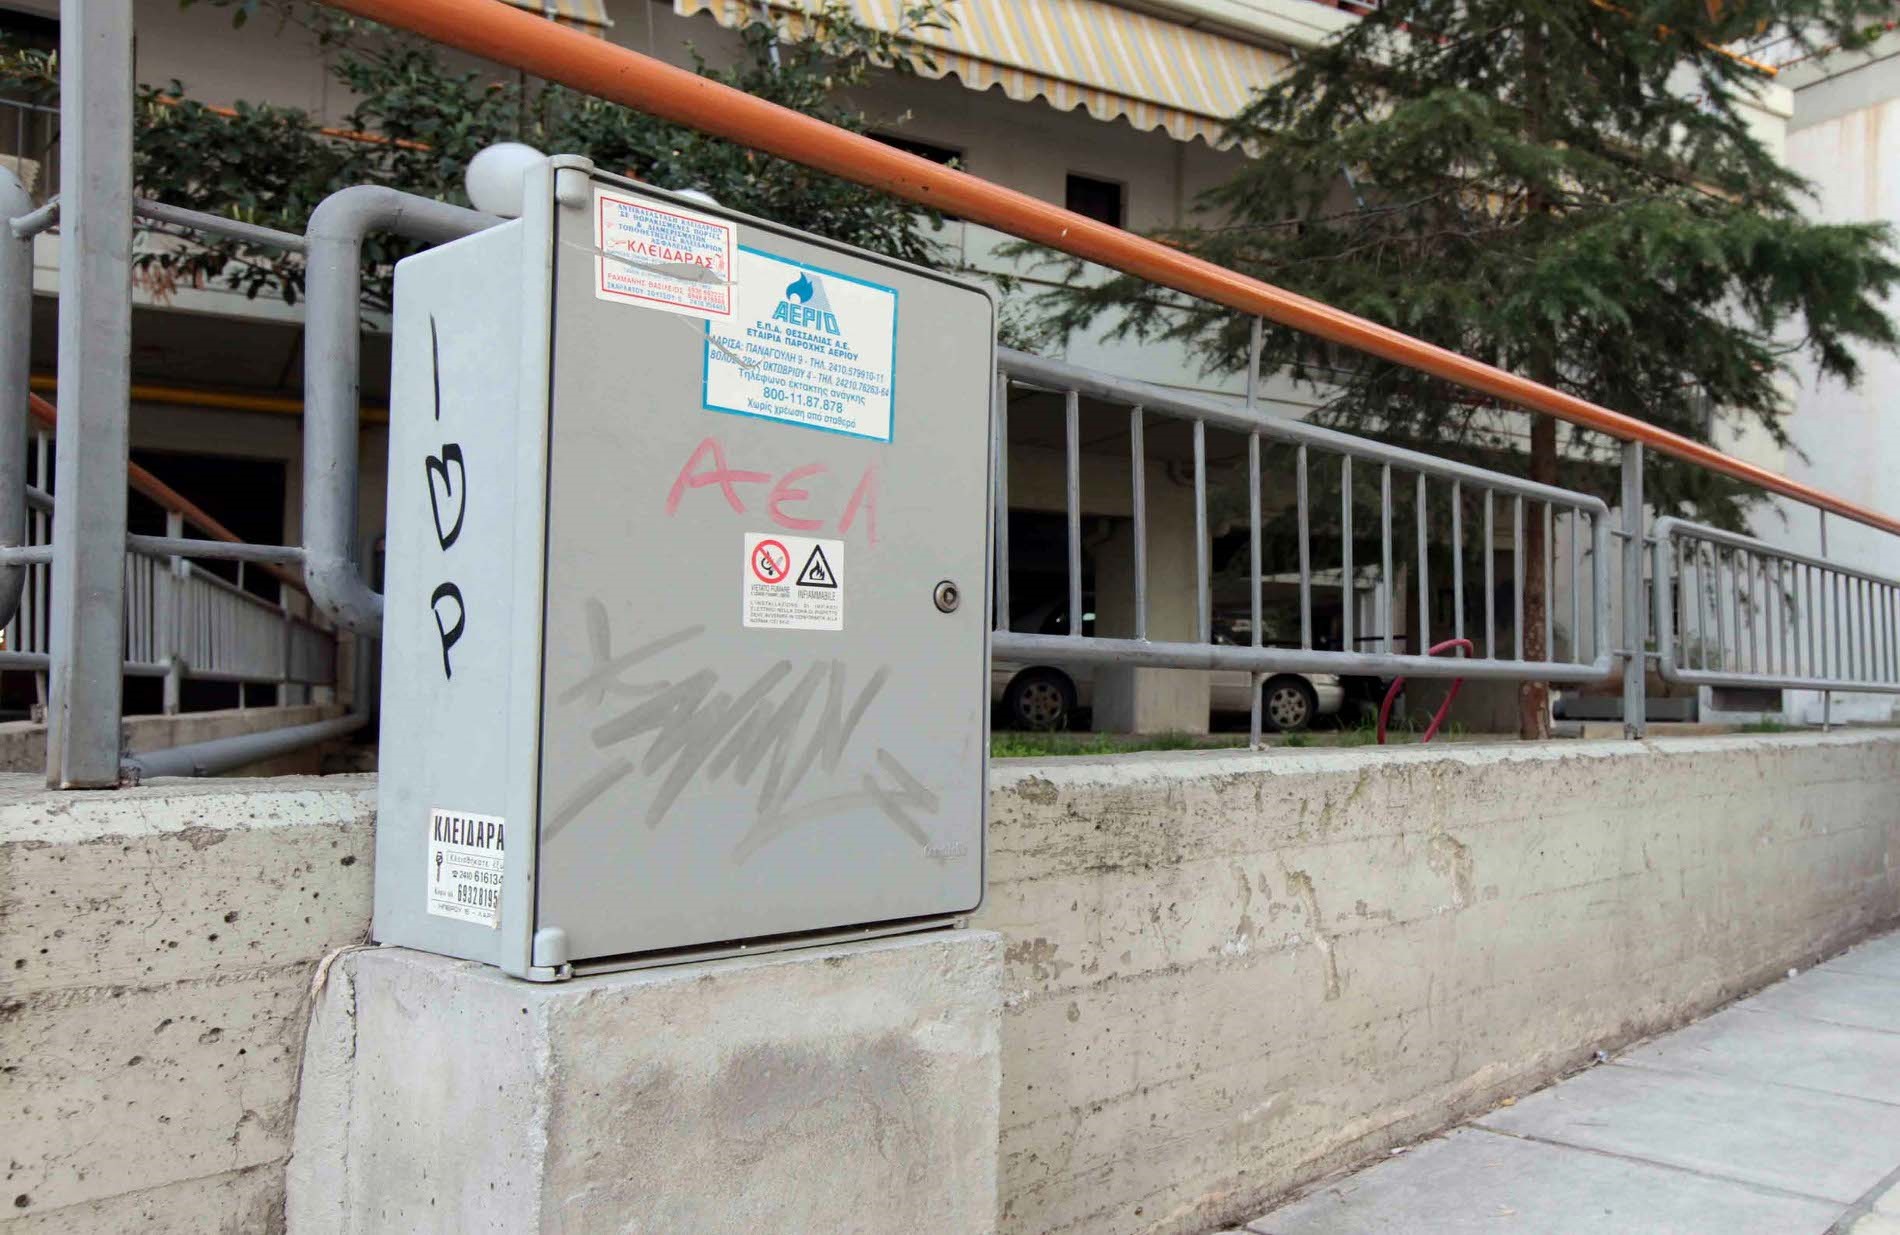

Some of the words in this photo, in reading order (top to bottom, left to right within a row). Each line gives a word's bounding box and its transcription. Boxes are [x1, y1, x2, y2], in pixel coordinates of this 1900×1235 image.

[627, 238, 713, 269] ΚΛΕΙΔΑΡΑΣ
[772, 298, 841, 336] ΑΕΡΙΟ
[746, 327, 781, 343] ΕΤΑΙΡΙΑ
[785, 336, 825, 353] ΠΑΡΟΧΗΣ
[828, 346, 858, 361] ΑΕΡΙΟΥ
[756, 319, 781, 334] Ε.Π.Α.
[785, 328, 831, 345] ΘΕΣΣΑΛΙΑΣ
[834, 339, 850, 350] Α.Ε.
[745, 342, 795, 362] ΠΑΝΑΓΟΥΛΗ
[763, 360, 804, 378] ΟΚΤΩΒΡΙΟΥ
[747, 397, 773, 413] Χωρίς
[774, 401, 803, 420] χρέωση
[763, 386, 843, 413] 800-11.87.878
[798, 590, 835, 601] INFIAMMABILE
[434, 814, 504, 851] ΚΛΕΙΔΑΡΑ
